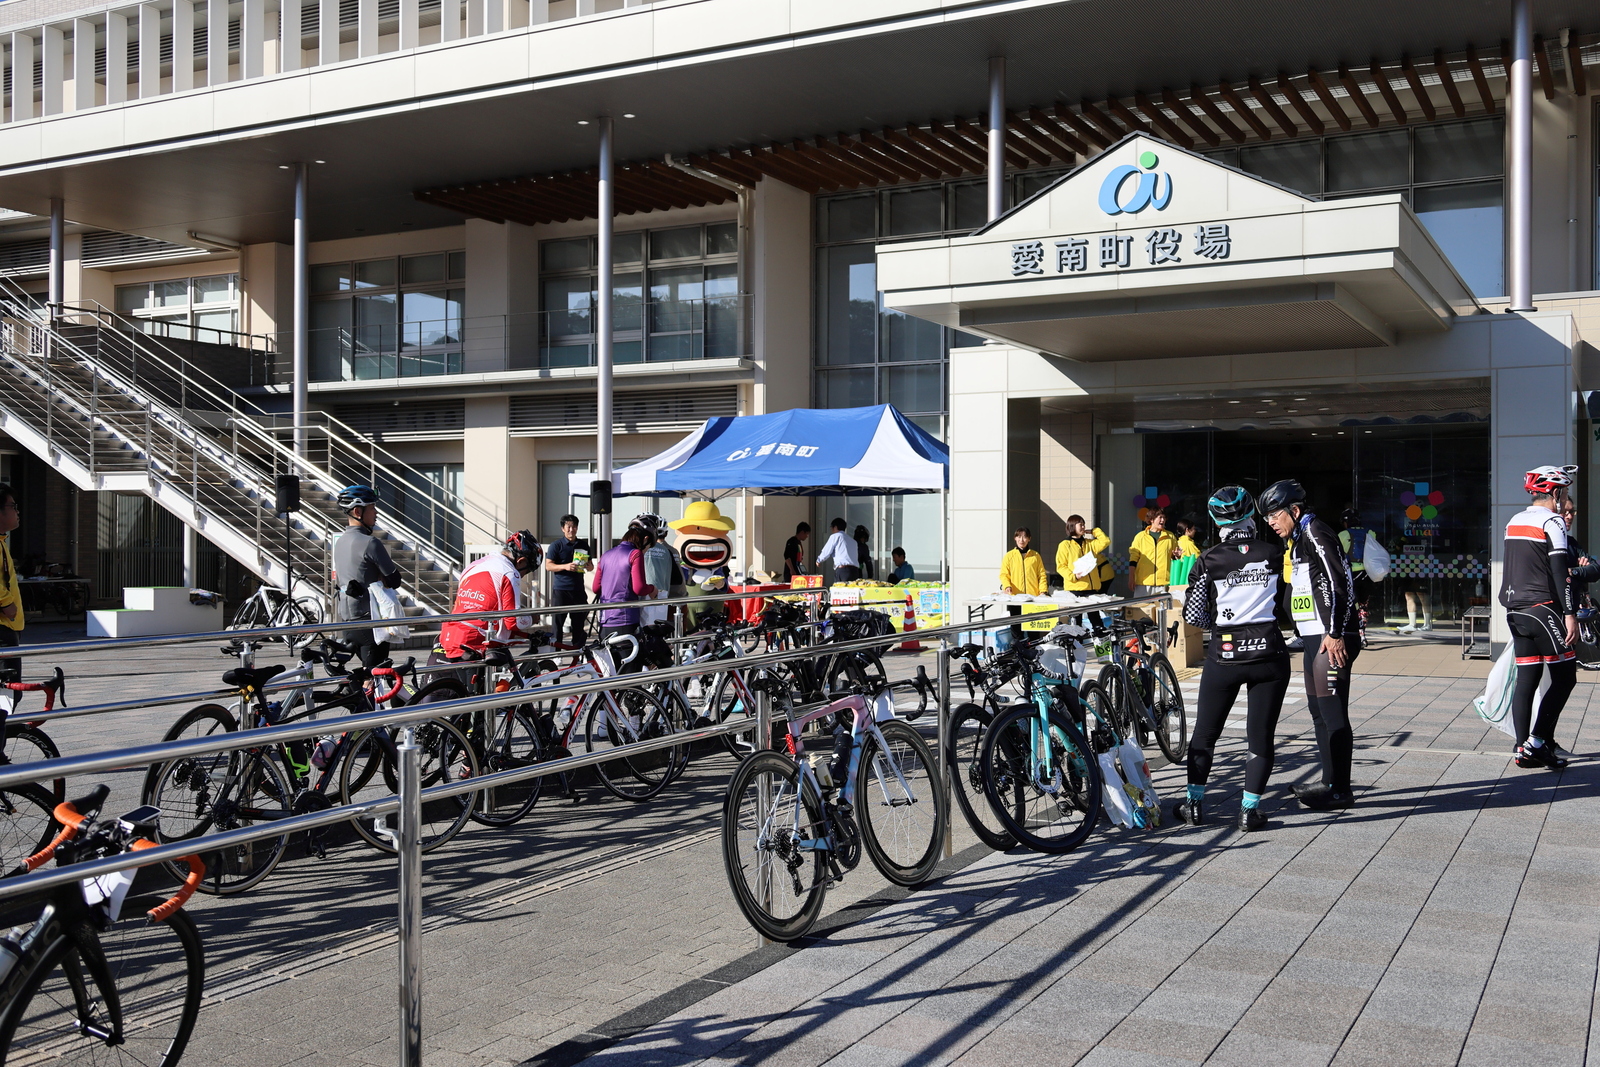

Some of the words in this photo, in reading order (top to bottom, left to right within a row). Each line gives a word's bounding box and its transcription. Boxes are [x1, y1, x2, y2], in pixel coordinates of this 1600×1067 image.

[1011, 224, 1233, 277] 愛南町役場
[1404, 529, 1441, 537] ainan
[1226, 570, 1271, 588] Racing
[832, 597, 858, 609] meiji
[1293, 597, 1311, 610] 020
[1237, 644, 1267, 652] GSG
